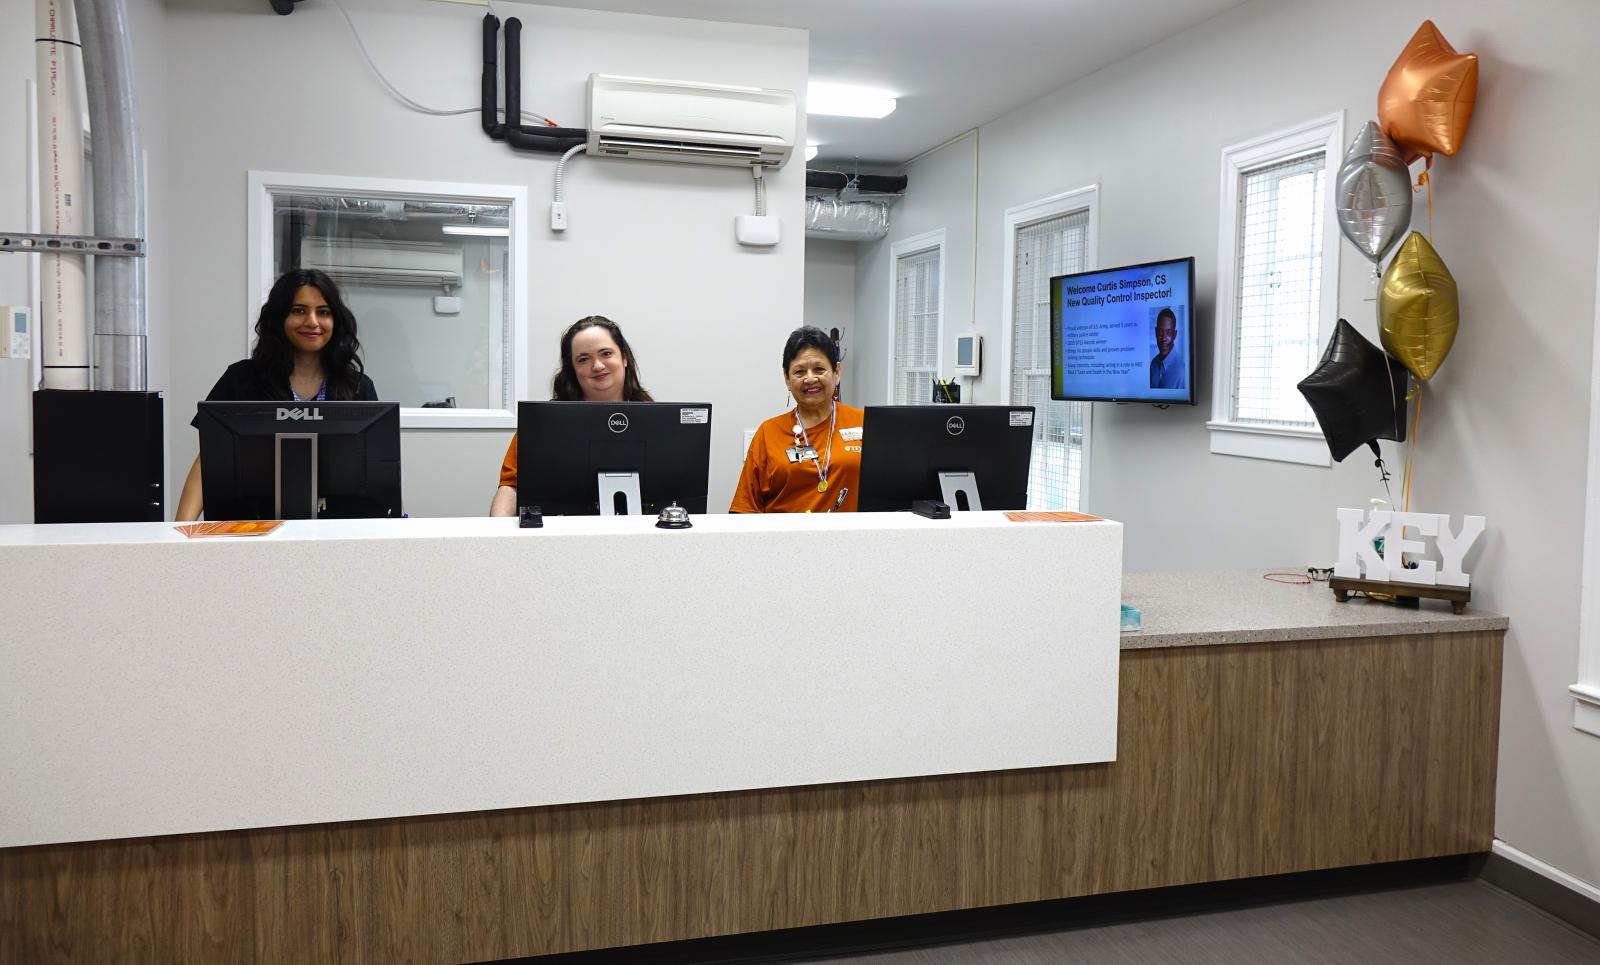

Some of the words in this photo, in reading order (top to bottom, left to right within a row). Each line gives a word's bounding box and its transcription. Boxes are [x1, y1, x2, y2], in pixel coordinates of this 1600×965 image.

[1067, 285, 1095, 295] Welcome
[1097, 281, 1117, 292] Curtis
[1120, 278, 1153, 290] Simpson,
[1155, 274, 1167, 285] CS
[1067, 299, 1080, 307] New
[1081, 295, 1104, 306] Quality
[1106, 292, 1133, 303] Control
[1134, 288, 1172, 300] Inspector!
[276, 407, 324, 421] DELL
[1334, 507, 1487, 587] KEY
